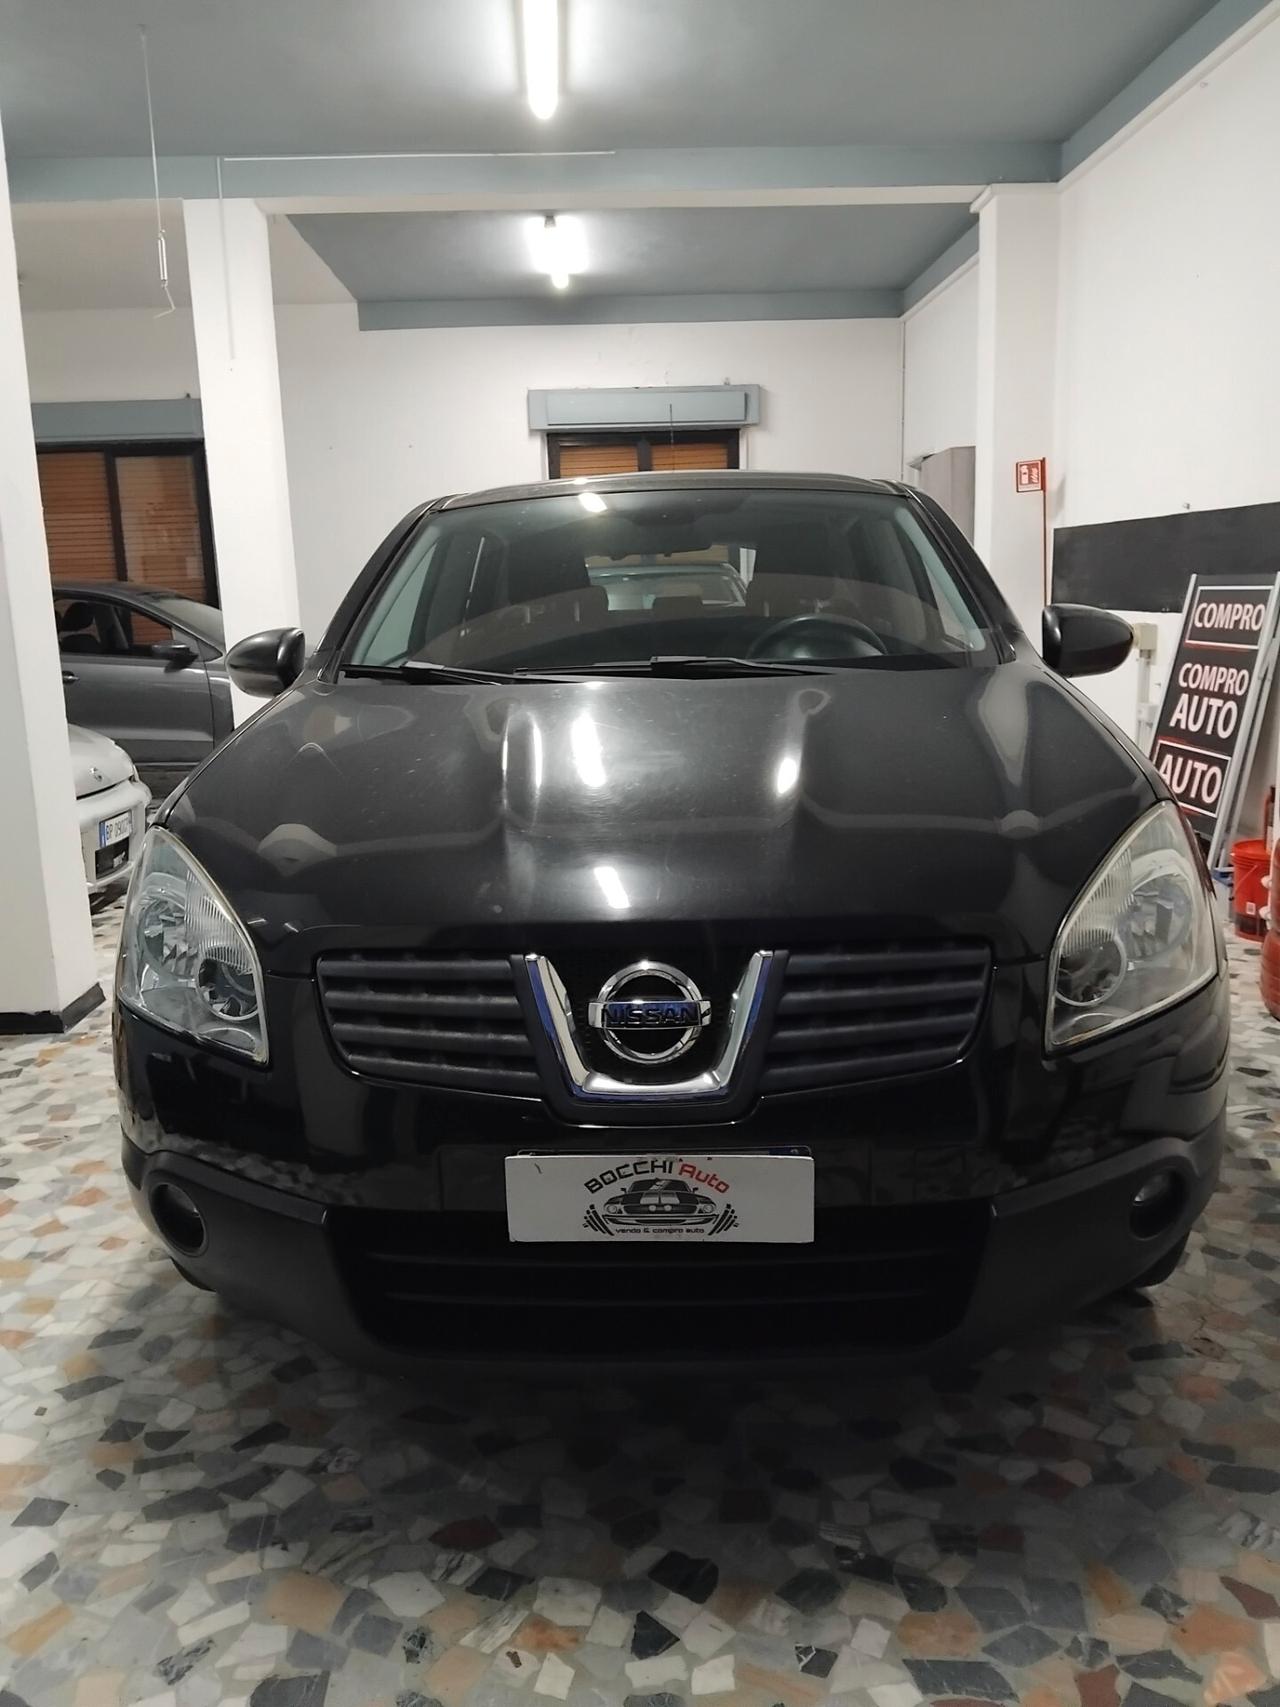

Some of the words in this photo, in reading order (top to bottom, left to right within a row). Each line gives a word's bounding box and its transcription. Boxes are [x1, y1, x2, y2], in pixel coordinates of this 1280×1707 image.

[1194, 603, 1265, 630] COMPRO
[1178, 662, 1250, 696] COMPRO
[1169, 693, 1238, 739] AUTO
[1160, 754, 1222, 804] AUTO
[605, 1006, 693, 1024] NISSAN
[584, 1160, 673, 1193] BOCCHI
[679, 1163, 730, 1193] Auto
